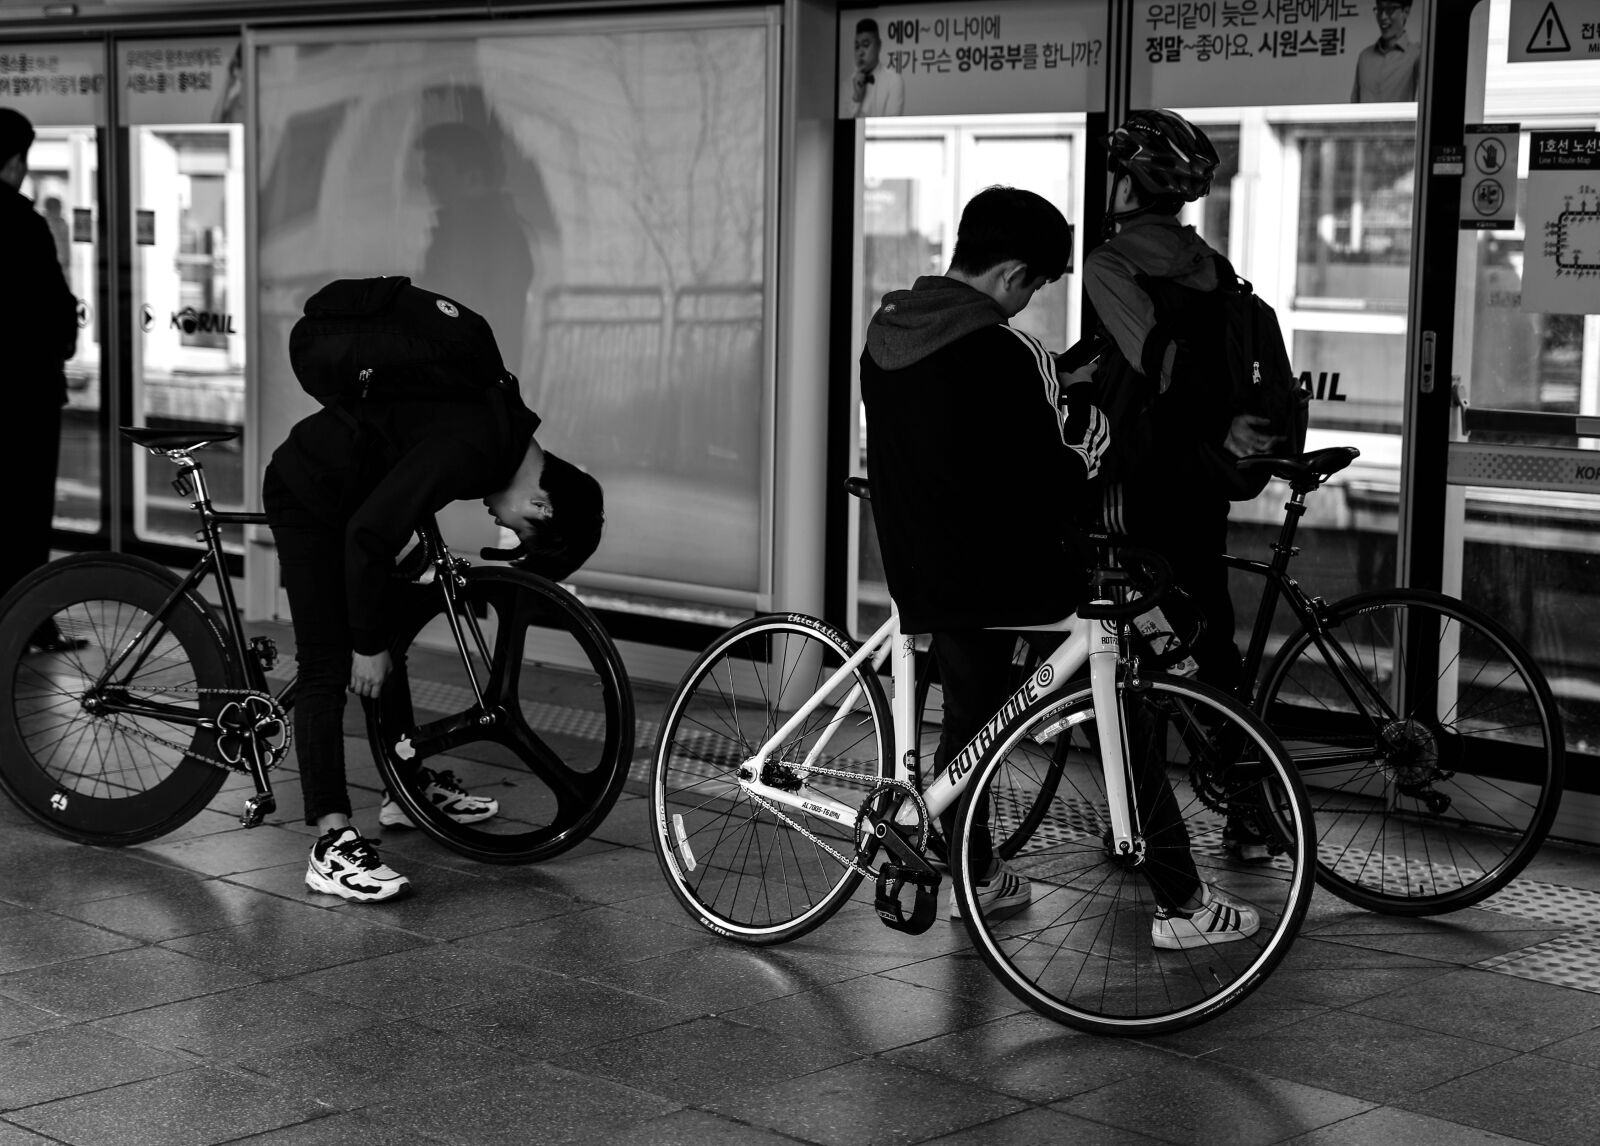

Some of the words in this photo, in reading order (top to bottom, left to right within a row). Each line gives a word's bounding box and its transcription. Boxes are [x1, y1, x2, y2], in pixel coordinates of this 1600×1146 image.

[888, 18, 931, 44] 에이~
[934, 17, 950, 43] 이
[953, 14, 1001, 42] 나이에
[1146, 1, 1216, 31] 우리같이
[1221, 0, 1259, 28] 늦은
[886, 49, 918, 75] 제가
[920, 48, 952, 74] 무슨
[955, 43, 1039, 73] 영어공부를
[1042, 39, 1103, 69] 합니까?
[1258, 26, 1346, 58] 시원스쿨!
[1538, 156, 1552, 165] Line
[1558, 156, 1576, 165] Route
[1577, 156, 1592, 166] Map
[1539, 138, 1569, 155] 1호선
